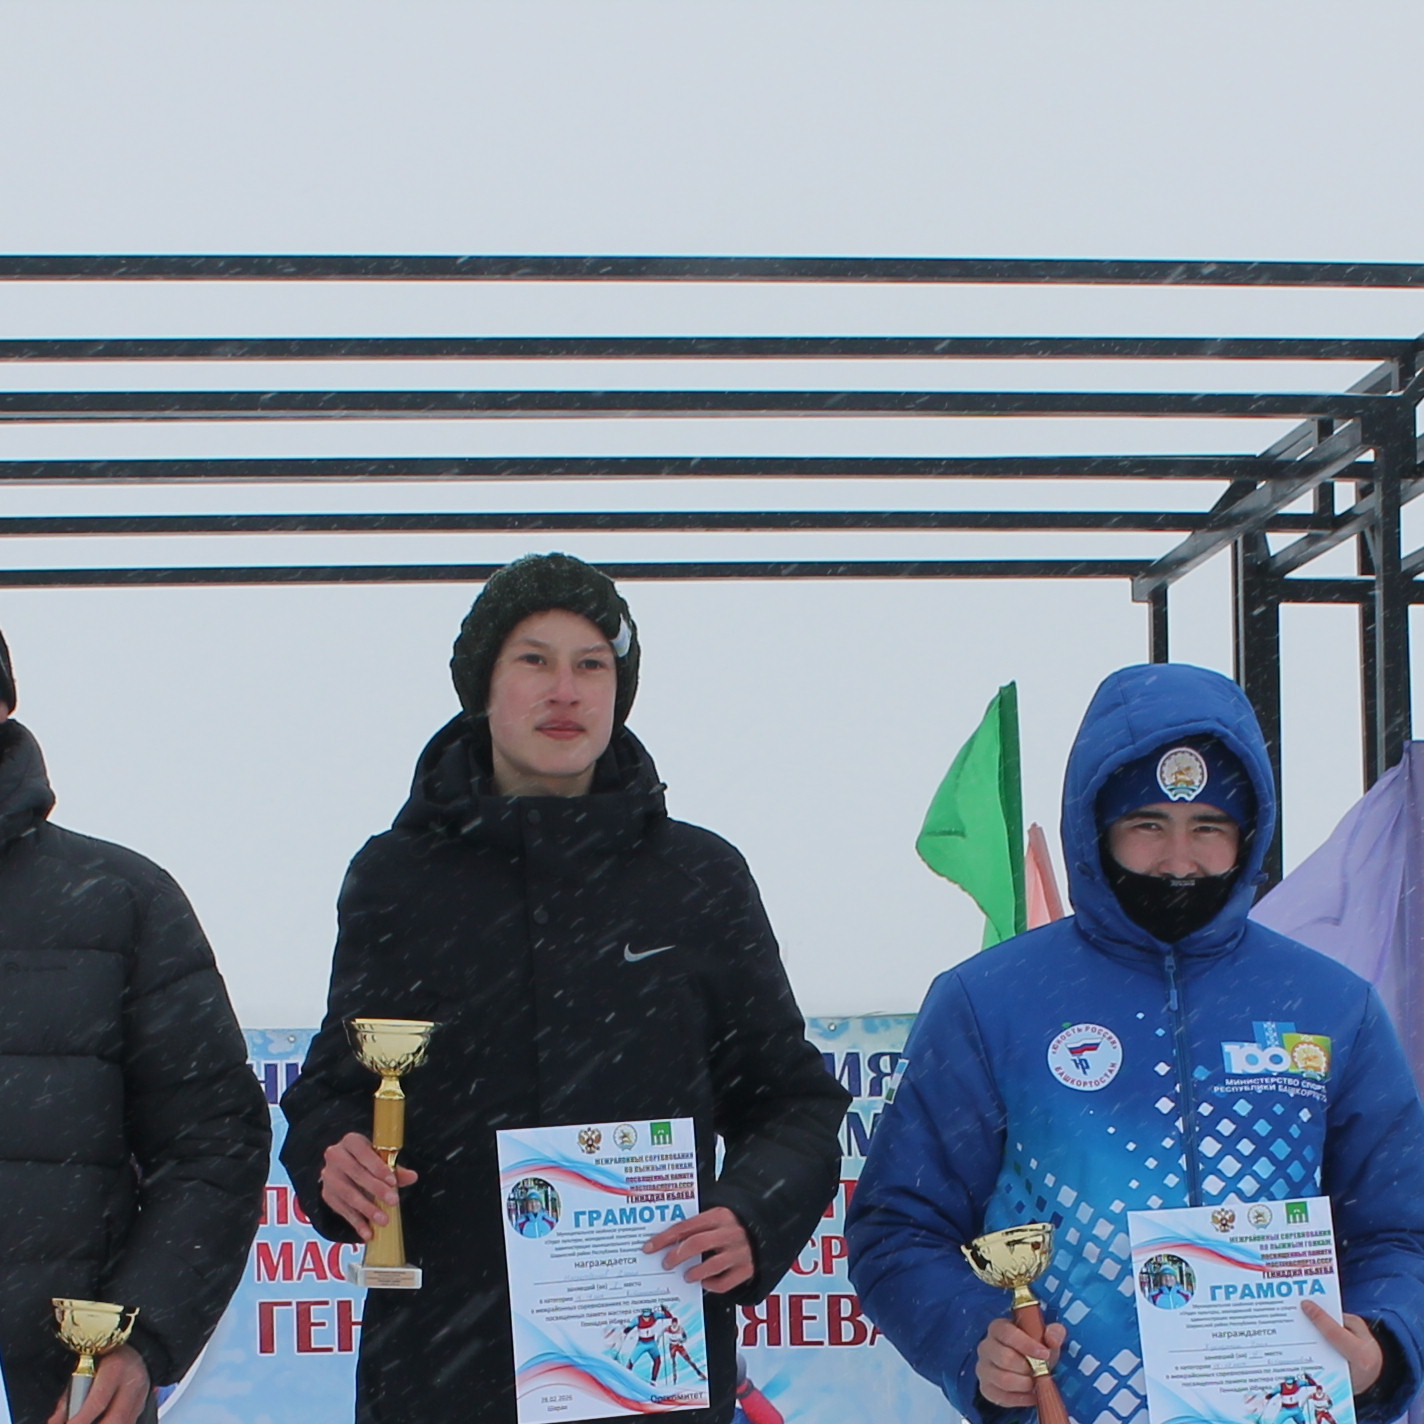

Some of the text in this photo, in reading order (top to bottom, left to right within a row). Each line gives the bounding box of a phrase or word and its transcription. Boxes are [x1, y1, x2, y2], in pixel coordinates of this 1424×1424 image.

[1223, 1042, 1292, 1074] 100
[1054, 1062, 1118, 1088] БАШКОРТОСТАН
[1224, 1076, 1300, 1087] МИНИСТЕРСТВО
[1213, 1084, 1276, 1093] РЕСПУБЛИКИ
[572, 1203, 685, 1228] ГРАМОТА
[574, 1256, 636, 1269] награждается
[1209, 1278, 1325, 1302] ГРАМОТА
[1211, 1327, 1276, 1339] награждается
[650, 1389, 703, 1403] Оргкомитет
